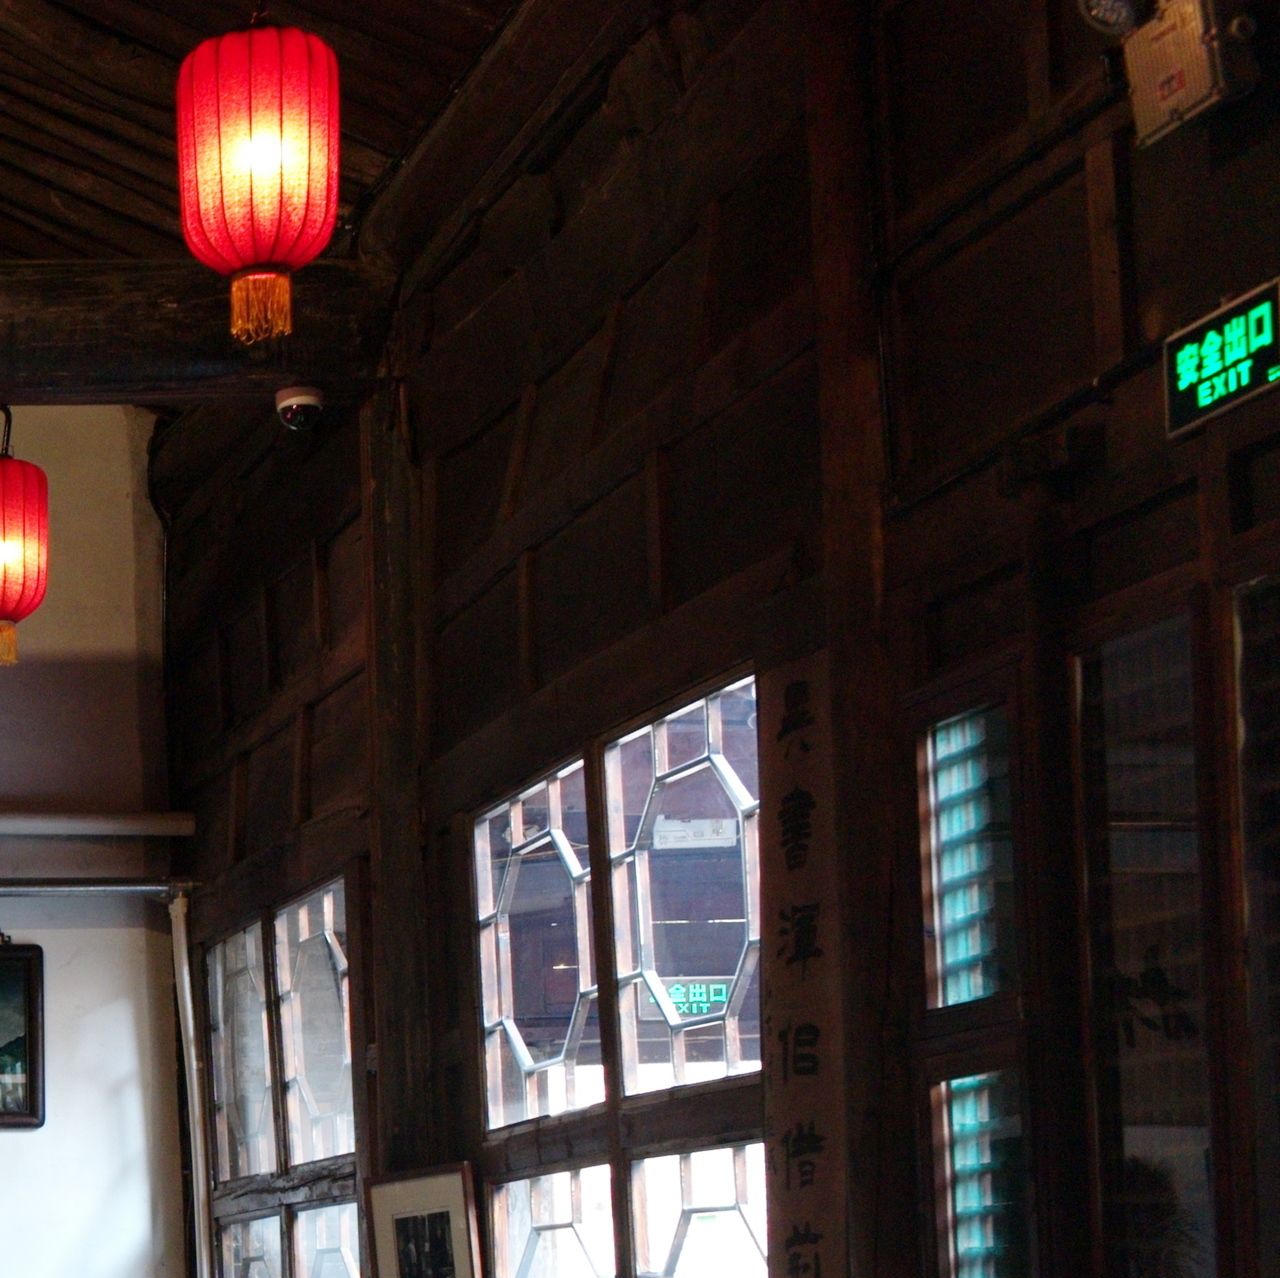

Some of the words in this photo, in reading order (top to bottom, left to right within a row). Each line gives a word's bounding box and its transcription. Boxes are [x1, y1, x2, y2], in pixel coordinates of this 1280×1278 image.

[1175, 300, 1273, 391] 安全出口
[1197, 358, 1254, 408] EXIT
[649, 983, 727, 1003] 全出口
[677, 1002, 711, 1014] XIT
